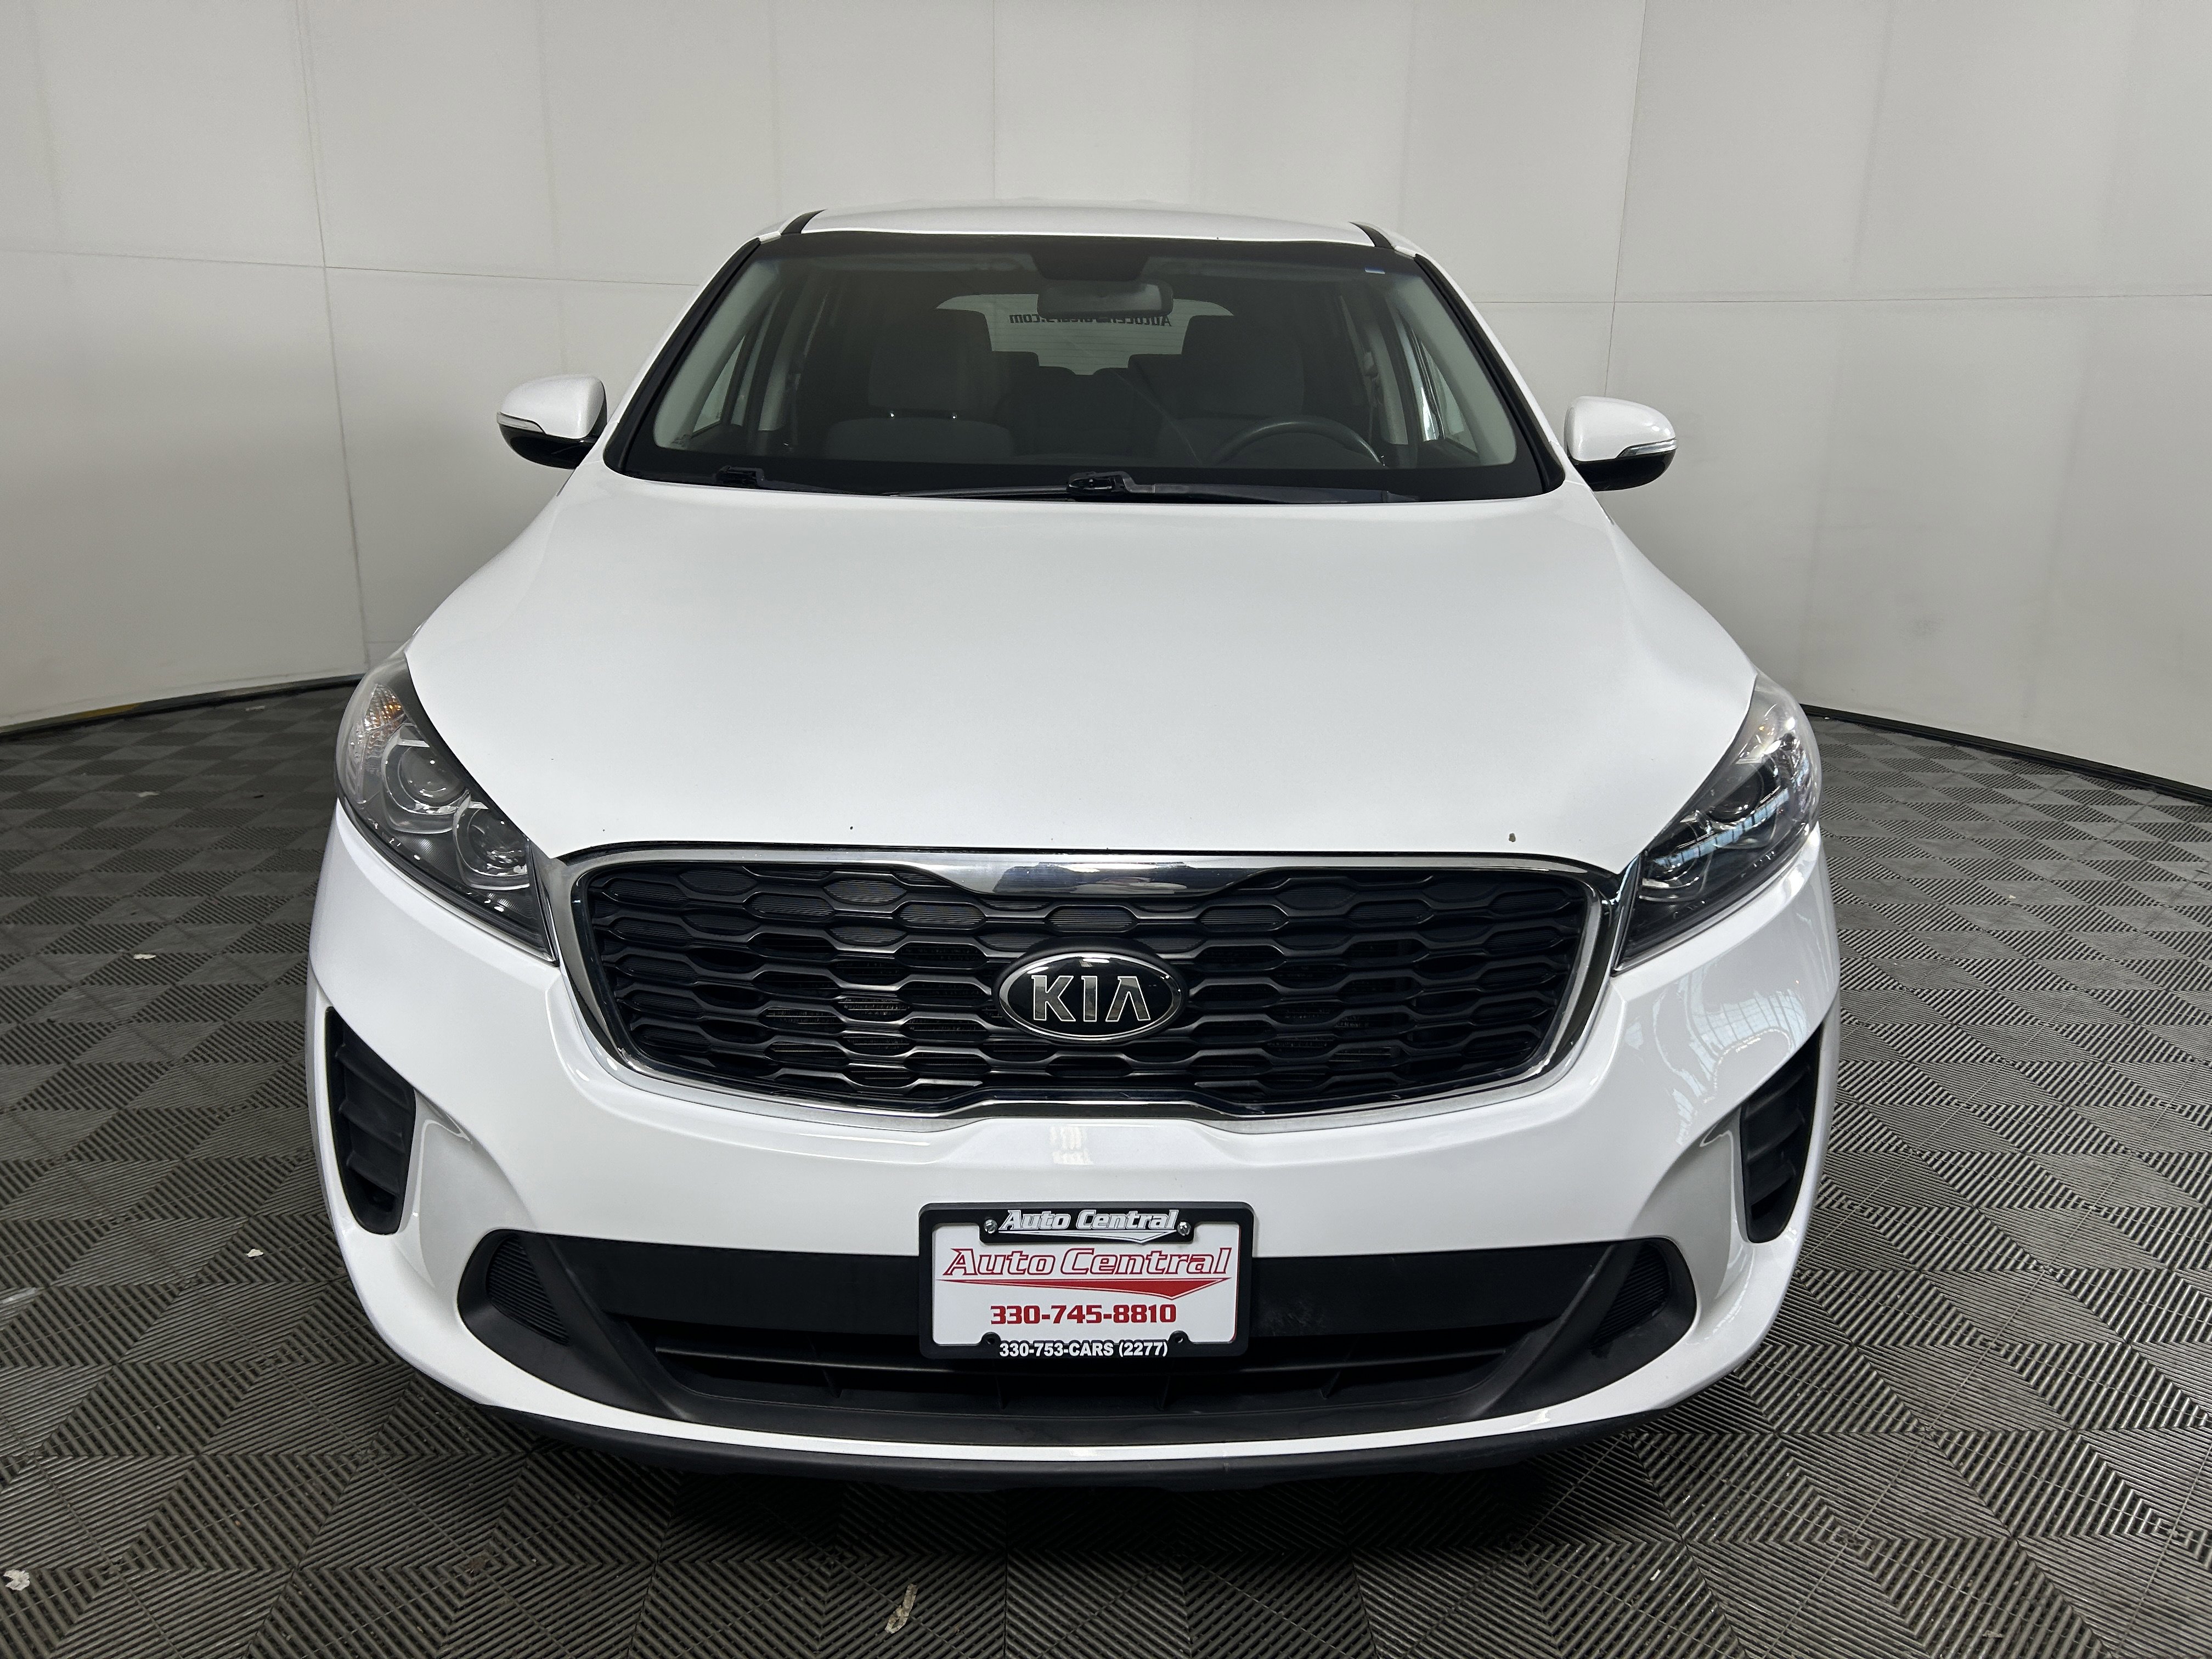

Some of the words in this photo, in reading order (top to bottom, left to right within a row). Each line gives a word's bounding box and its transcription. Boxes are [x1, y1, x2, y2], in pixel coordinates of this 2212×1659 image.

[1031, 975, 1151, 1022] KIA
[998, 1210, 1071, 1231] Auto
[1076, 1210, 1180, 1231] Central
[943, 1248, 1056, 1276] Auto
[1060, 1247, 1232, 1276] Central
[990, 1304, 1177, 1324] 330-745-8810
[999, 1341, 1114, 1357] 330-753-CARS
[1119, 1341, 1169, 1357] (2277)
